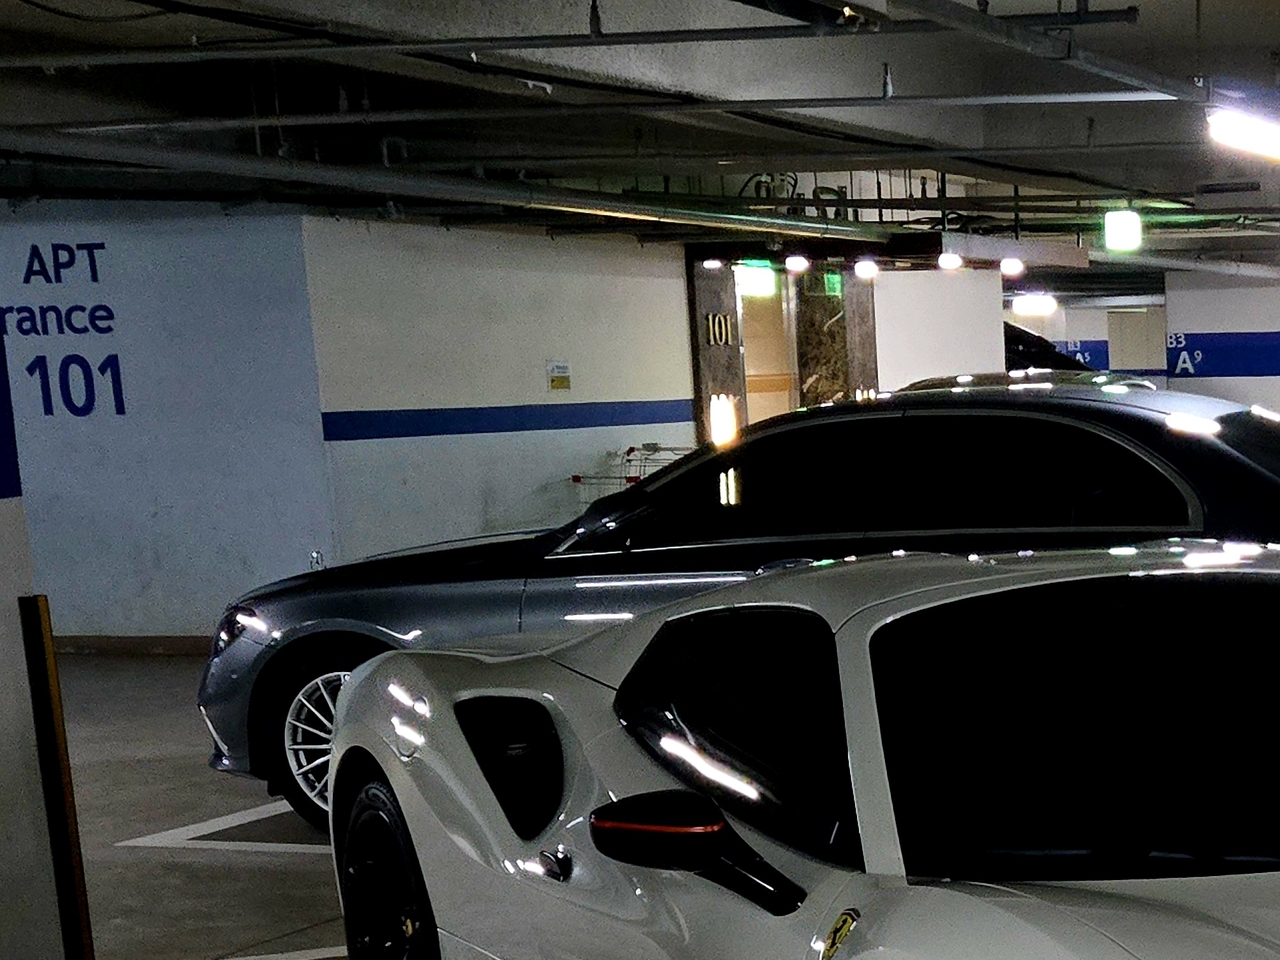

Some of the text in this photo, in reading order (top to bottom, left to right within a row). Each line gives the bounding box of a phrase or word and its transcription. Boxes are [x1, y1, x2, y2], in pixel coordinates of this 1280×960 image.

[22, 242, 106, 285] APT
[0, 304, 115, 336] rance
[706, 312, 733, 346] 101
[1166, 333, 1187, 348] B3
[24, 353, 127, 418] 101
